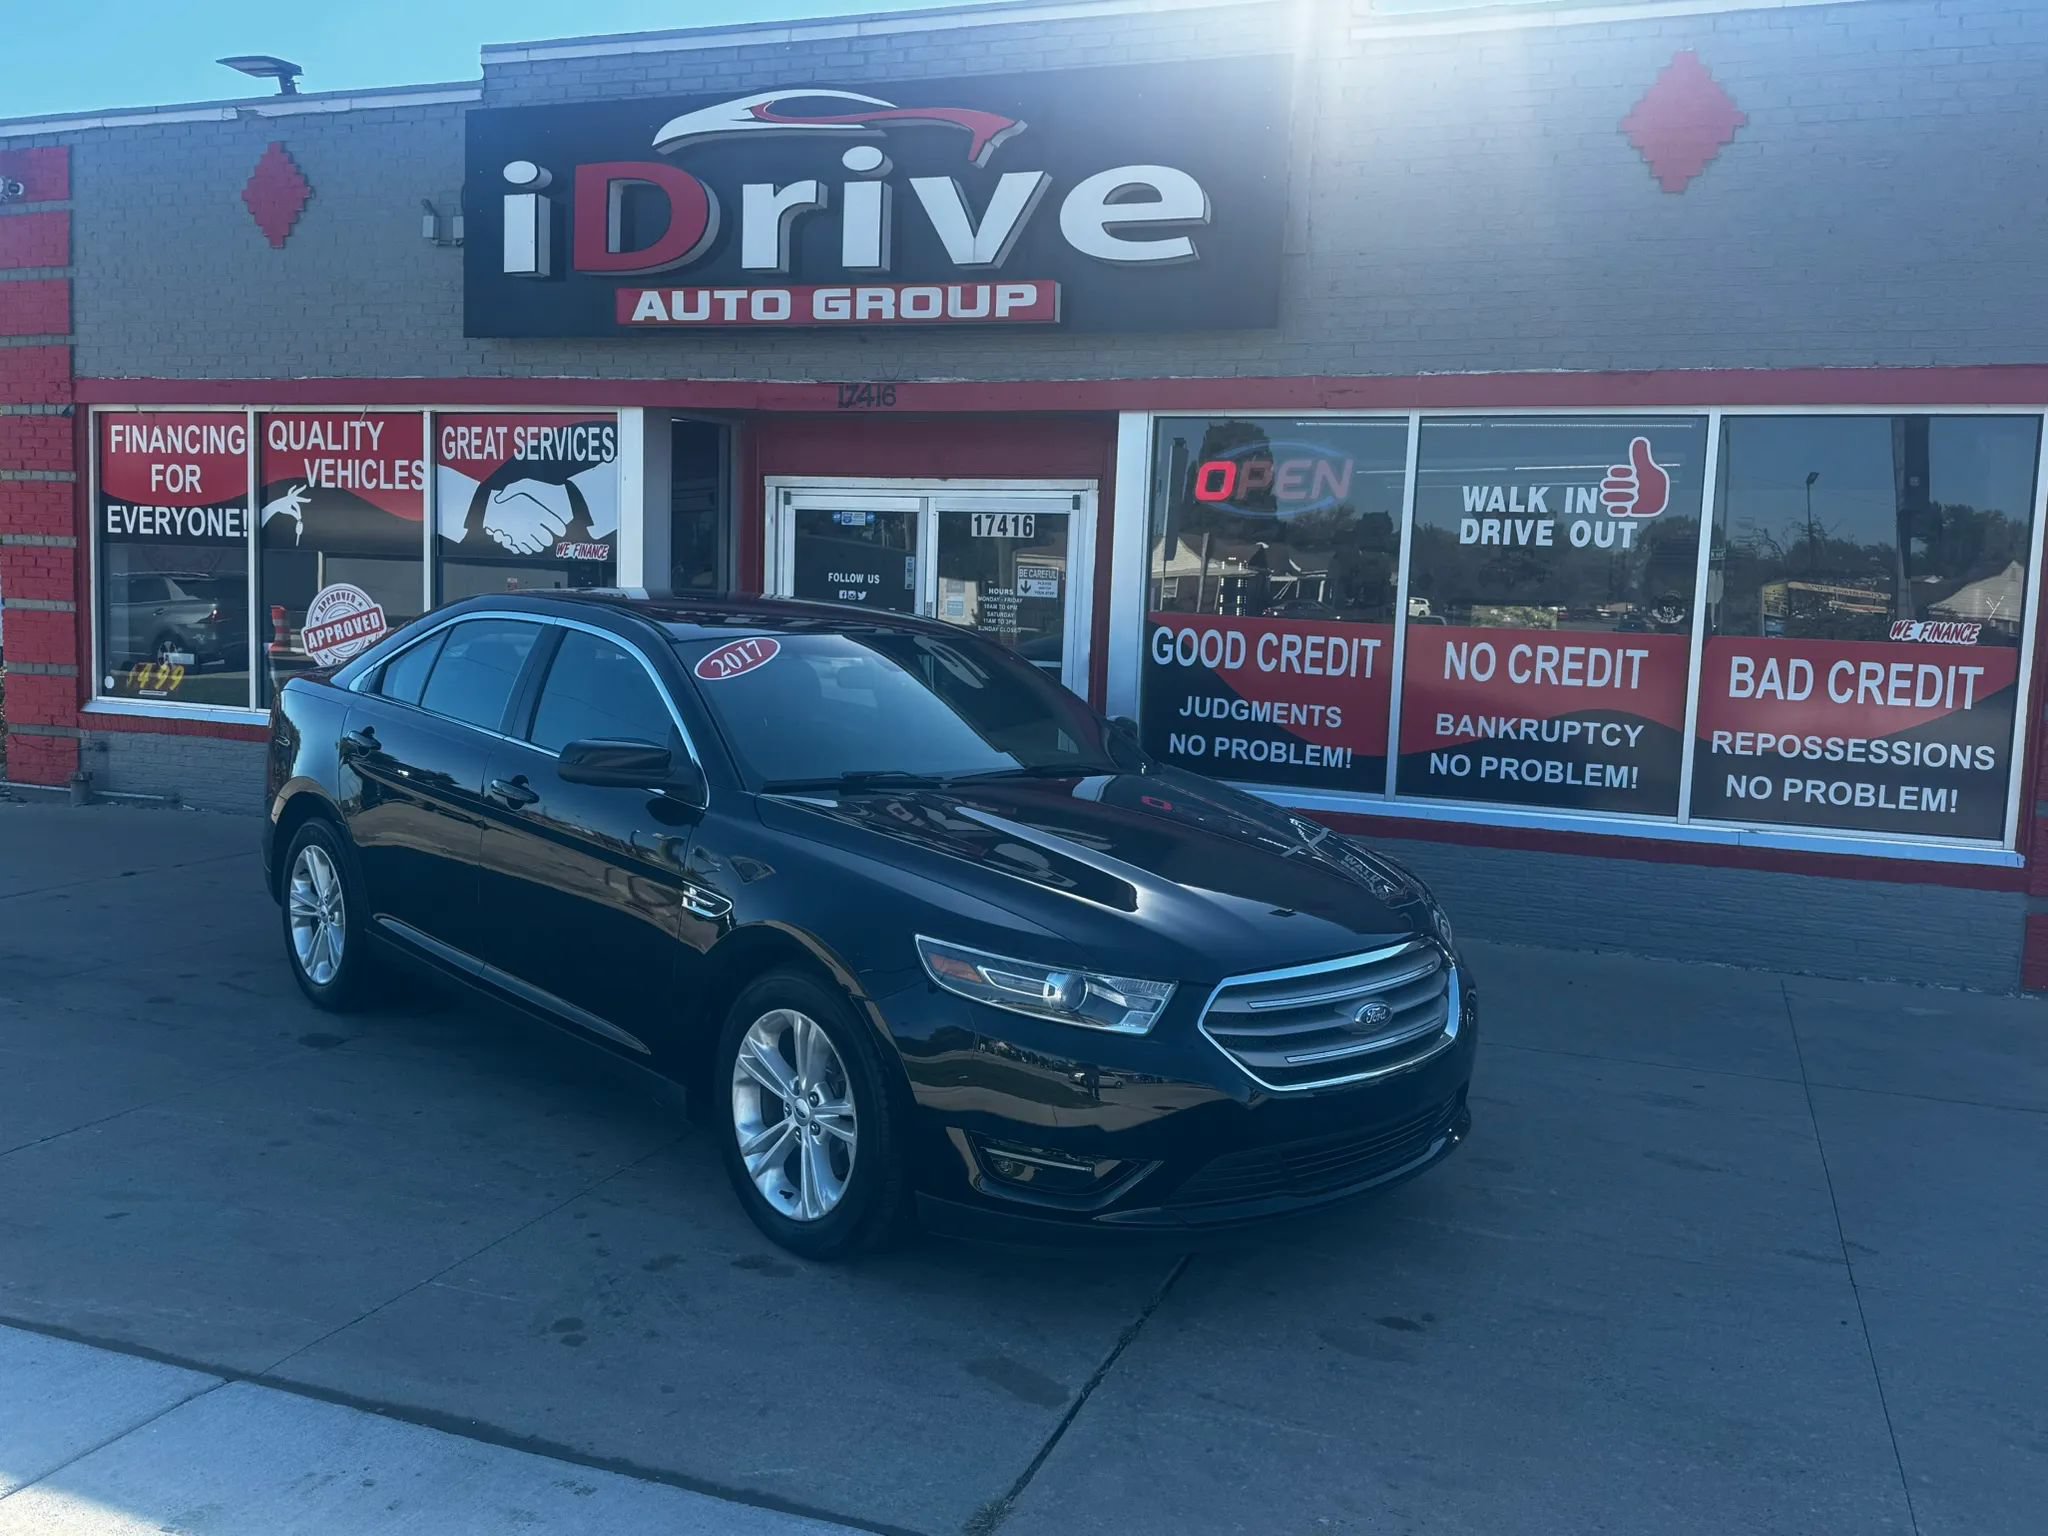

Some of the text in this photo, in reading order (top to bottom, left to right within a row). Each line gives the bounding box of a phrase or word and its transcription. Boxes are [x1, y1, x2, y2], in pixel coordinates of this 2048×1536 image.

[631, 283, 1038, 322] AUTO GROUP
[838, 384, 896, 408] 17416
[110, 425, 246, 455] FINANCING
[268, 420, 384, 451] QUALITY
[441, 426, 615, 462] GREAT SERVICES
[151, 464, 202, 493] FOR
[304, 458, 424, 490] VEHICLES
[1195, 459, 1354, 501] OPEN
[1462, 486, 1598, 514] WALK IN
[107, 505, 248, 537] EVERYONE!
[974, 514, 1033, 537] 17416
[1459, 519, 1638, 548] DRIVE OUT
[555, 542, 609, 560] WE FINANCE
[828, 572, 880, 584] FOLLOW US
[1019, 568, 1029, 578] BE
[318, 592, 356, 613] APPROVED
[988, 587, 1014, 595] HOURS
[307, 612, 380, 649] APPROVED
[1890, 620, 1982, 645] WE FINANCE
[711, 640, 762, 676] 2017
[1152, 626, 1381, 679] GOOD CREDIT
[1444, 641, 1649, 689] NO CREDIT
[1728, 656, 1984, 710] BAD CREDIT
[1179, 695, 1343, 728] JUDGMENTS
[1435, 713, 1644, 748] BANKRUPTCY
[1169, 733, 1353, 769] NO PROBLEM!
[1712, 731, 1996, 771] REPOSSESSIONS
[1429, 752, 1639, 789] NO PROBLEM!
[1726, 774, 1958, 813] NO PROBLEM!
[1366, 1006, 1386, 1024] Ford
